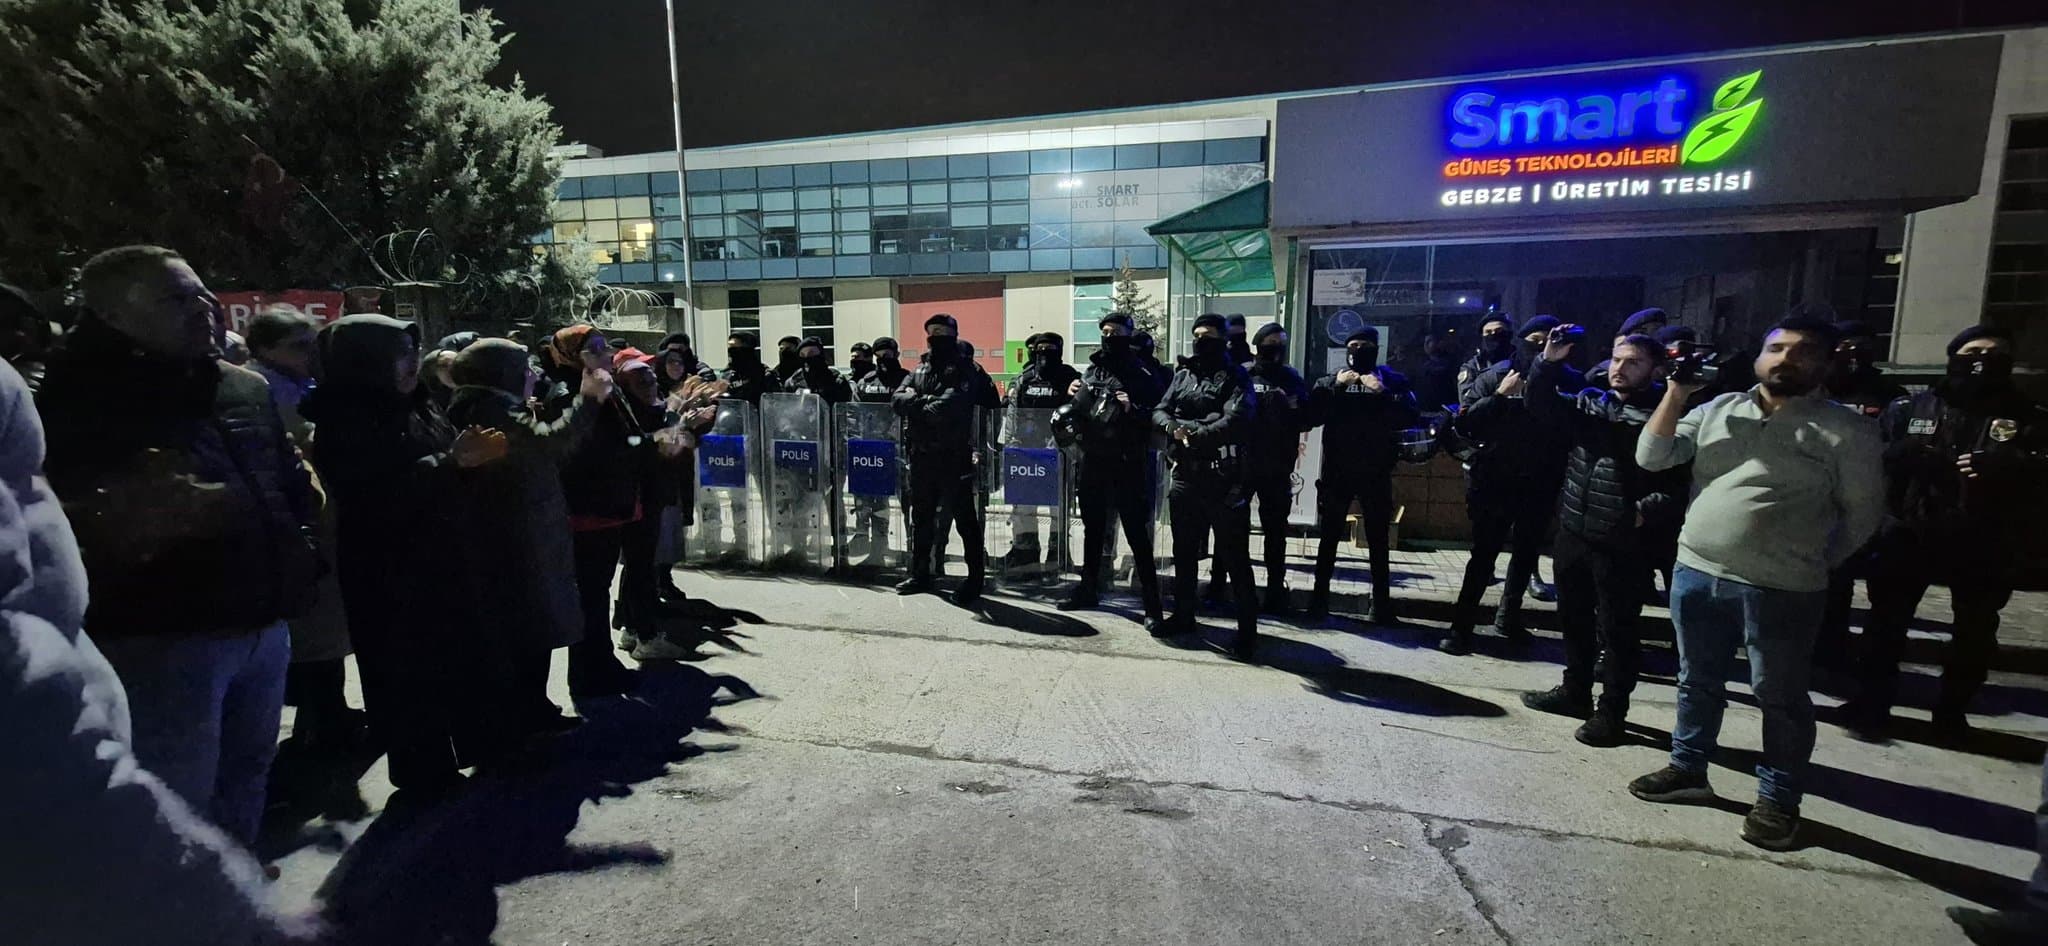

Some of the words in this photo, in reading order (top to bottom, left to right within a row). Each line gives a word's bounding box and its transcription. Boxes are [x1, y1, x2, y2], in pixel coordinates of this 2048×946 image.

[1450, 79, 1687, 148] Smart
[1444, 157, 1511, 177] GÜNEŞ
[1516, 145, 1678, 172] TEKNOLOJİLERİ
[1098, 184, 1139, 195] SMART
[1442, 186, 1522, 206] GEBZE
[1552, 178, 1649, 200] ÜRETİM
[1662, 171, 1752, 194] TESİSİ
[1097, 196, 1138, 207] SOLAR
[708, 455, 735, 466] POLİS
[781, 449, 809, 461] POLİS
[853, 455, 883, 468] POLİS
[1010, 464, 1045, 476] POLİS
